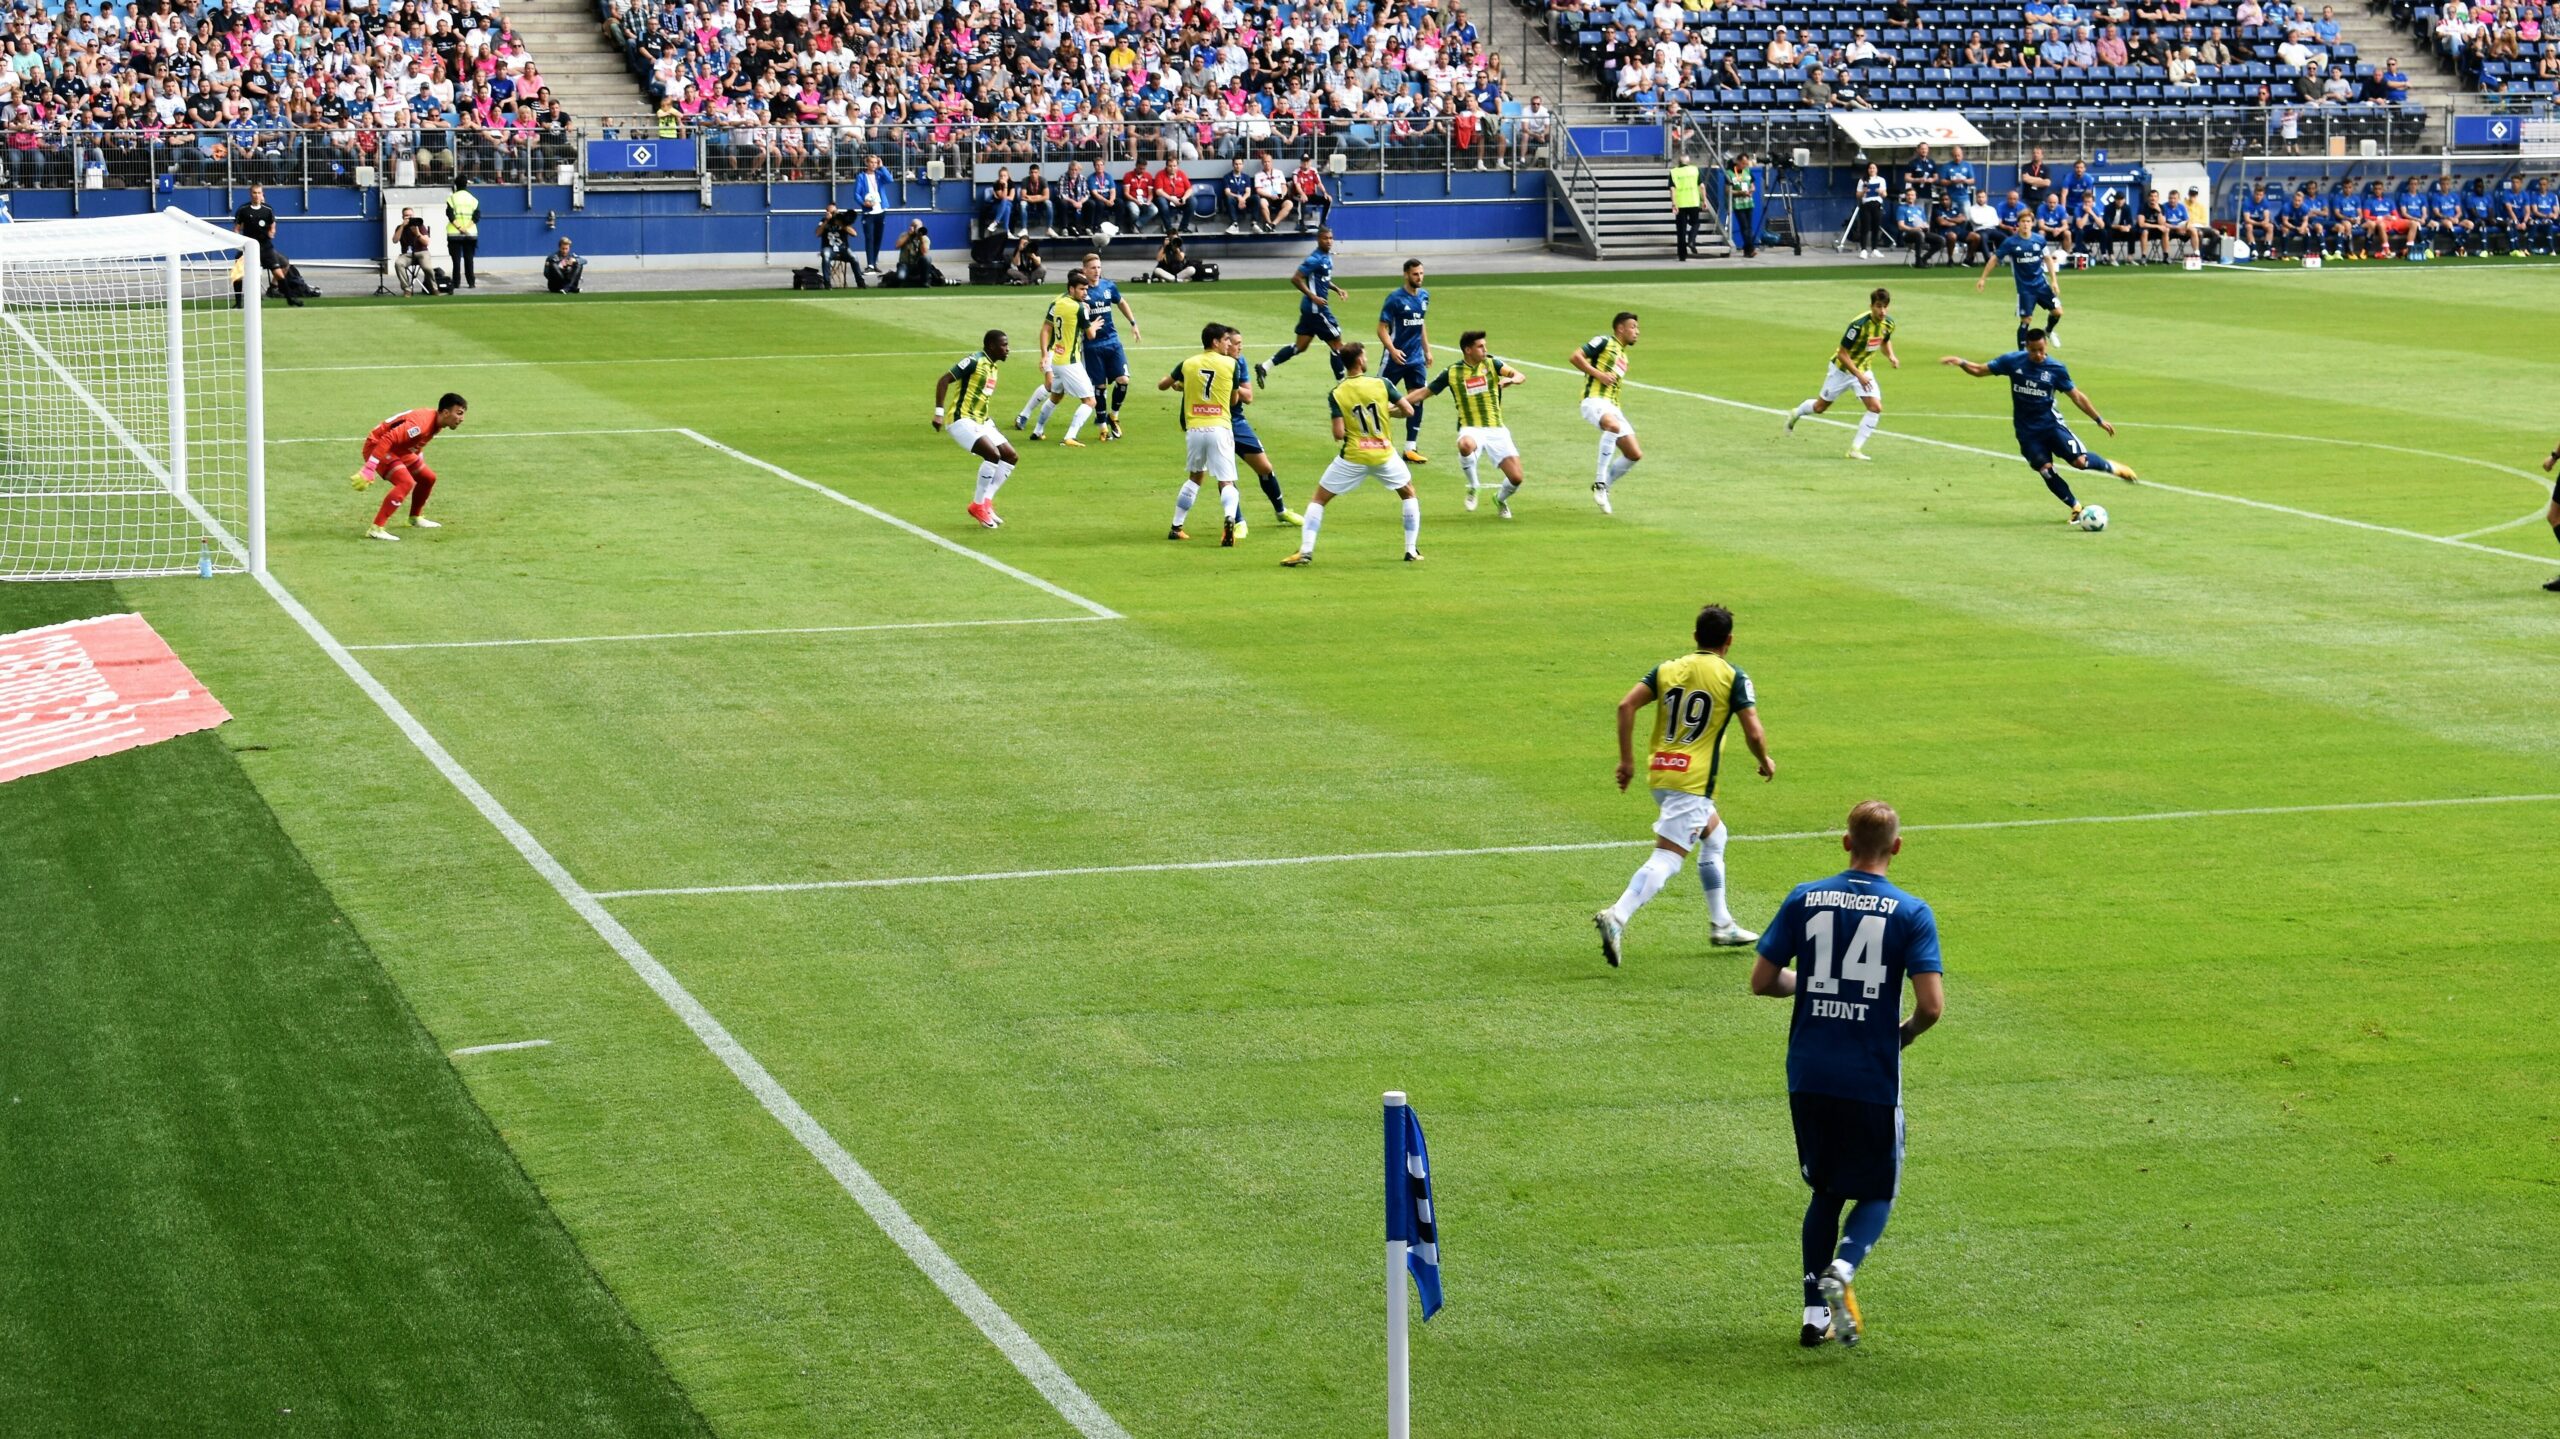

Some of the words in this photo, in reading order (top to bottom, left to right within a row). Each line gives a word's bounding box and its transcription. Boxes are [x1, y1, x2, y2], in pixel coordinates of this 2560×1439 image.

[1864, 122, 1934, 141] NDR
[1935, 127, 1958, 139] 2
[164, 179, 169, 188] 1
[1055, 315, 1064, 341] 3
[1199, 369, 1216, 401] 7
[2013, 383, 2048, 397] Emirates
[1352, 401, 1383, 437] 11
[2067, 440, 2078, 454] 7
[1664, 686, 1713, 745] 19
[1805, 890, 1879, 911] HAMBURGER
[1878, 896, 1899, 914] SV
[1805, 910, 1888, 1000] 14
[1811, 999, 1870, 1022] HUNT
